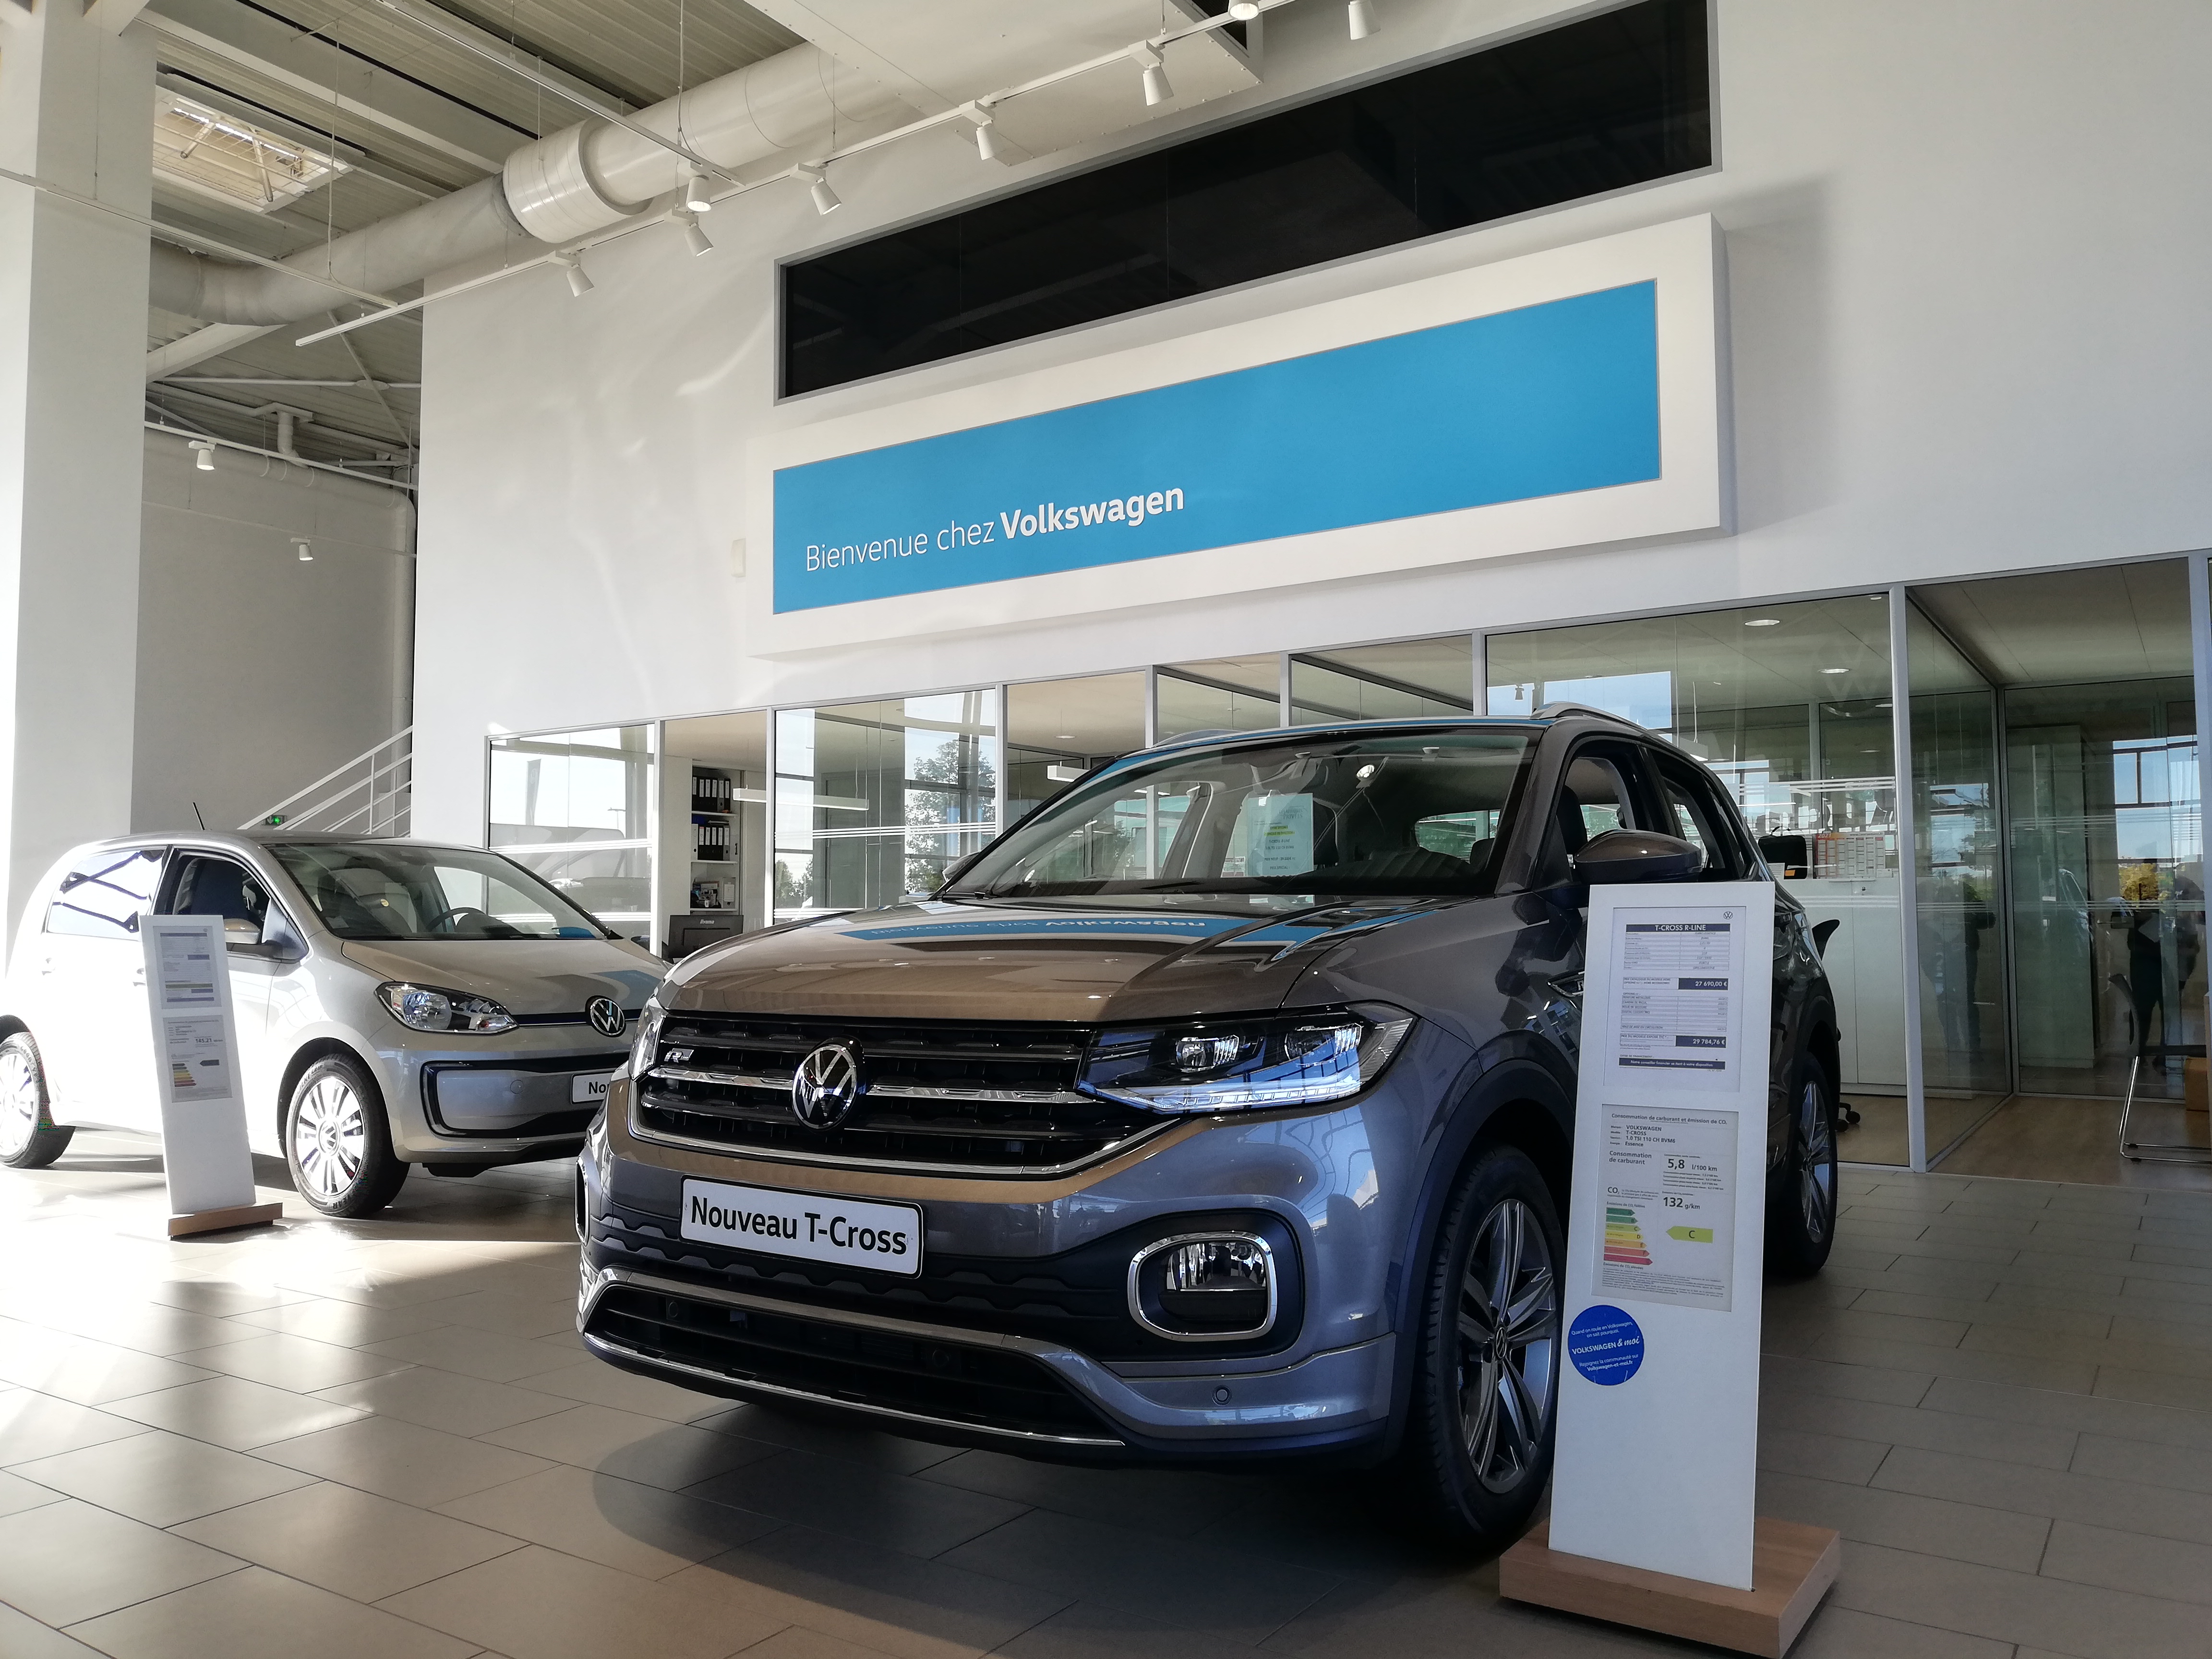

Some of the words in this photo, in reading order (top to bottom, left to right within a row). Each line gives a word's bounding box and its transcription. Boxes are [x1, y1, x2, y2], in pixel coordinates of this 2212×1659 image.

[806, 532, 928, 572] Bienvenue
[937, 520, 995, 551] chez
[999, 487, 1184, 540] Volkswagen
[1609, 1150, 1652, 1158] Consommation
[1668, 1158, 1685, 1170] 5,8
[1663, 1197, 1683, 1208] 132
[691, 1195, 797, 1239] Nouveau
[804, 1212, 907, 1255] T-Cross
[1688, 1230, 1695, 1239] C
[1572, 1342, 1616, 1355] VOLKSWAGEN
[1617, 1338, 1623, 1347] &
[1624, 1336, 1640, 1346] moi
